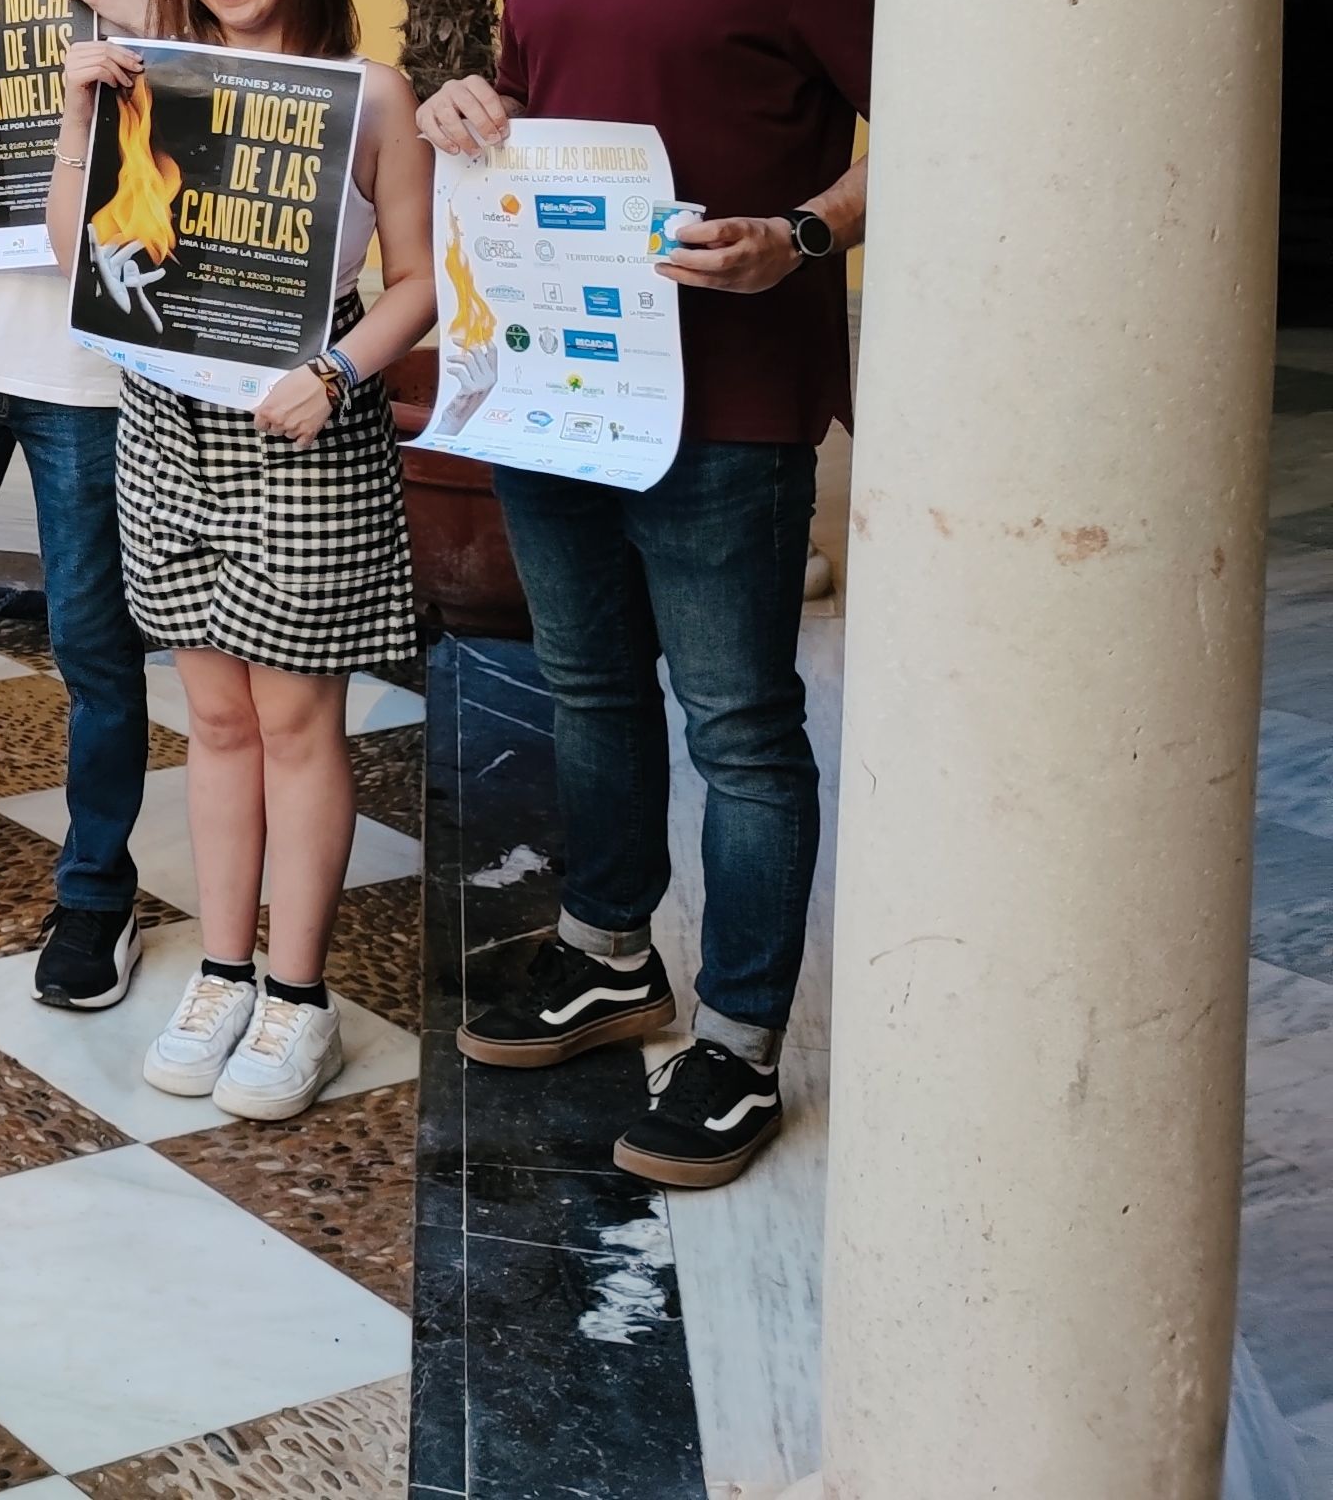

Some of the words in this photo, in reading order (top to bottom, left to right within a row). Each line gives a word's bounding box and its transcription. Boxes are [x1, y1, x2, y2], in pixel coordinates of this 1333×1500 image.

[3, 27, 30, 72] DE
[33, 22, 73, 68] LAS
[212, 72, 270, 90] VIERNES
[271, 81, 287, 92] 24
[288, 84, 333, 98] JUNIO
[9, 122, 24, 130] POR
[211, 87, 238, 136] VI
[240, 92, 331, 150] NOCHE
[14, 151, 29, 159] DEL
[535, 146, 550, 170] DE
[555, 146, 579, 171] LAS
[583, 146, 649, 172] CANDELAS
[229, 143, 266, 194] DE
[267, 149, 321, 203] LAS
[510, 174, 529, 182] UNA
[553, 175, 573, 183] POR
[576, 175, 589, 183] LA
[179, 188, 313, 255] CANDELAS
[178, 237, 199, 248] UNA
[200, 241, 218, 252] LUZ
[219, 244, 238, 255] POR
[240, 248, 252, 258] LA
[565, 252, 615, 263] TERRITORIO
[186, 271, 217, 284] PLAZA
[218, 276, 237, 287] DEL
[239, 280, 273, 292] BANCO
[275, 285, 306, 298] JEREZ
[199, 262, 212, 272] DE
[238, 270, 245, 278] A
[273, 275, 307, 287] HORAS
